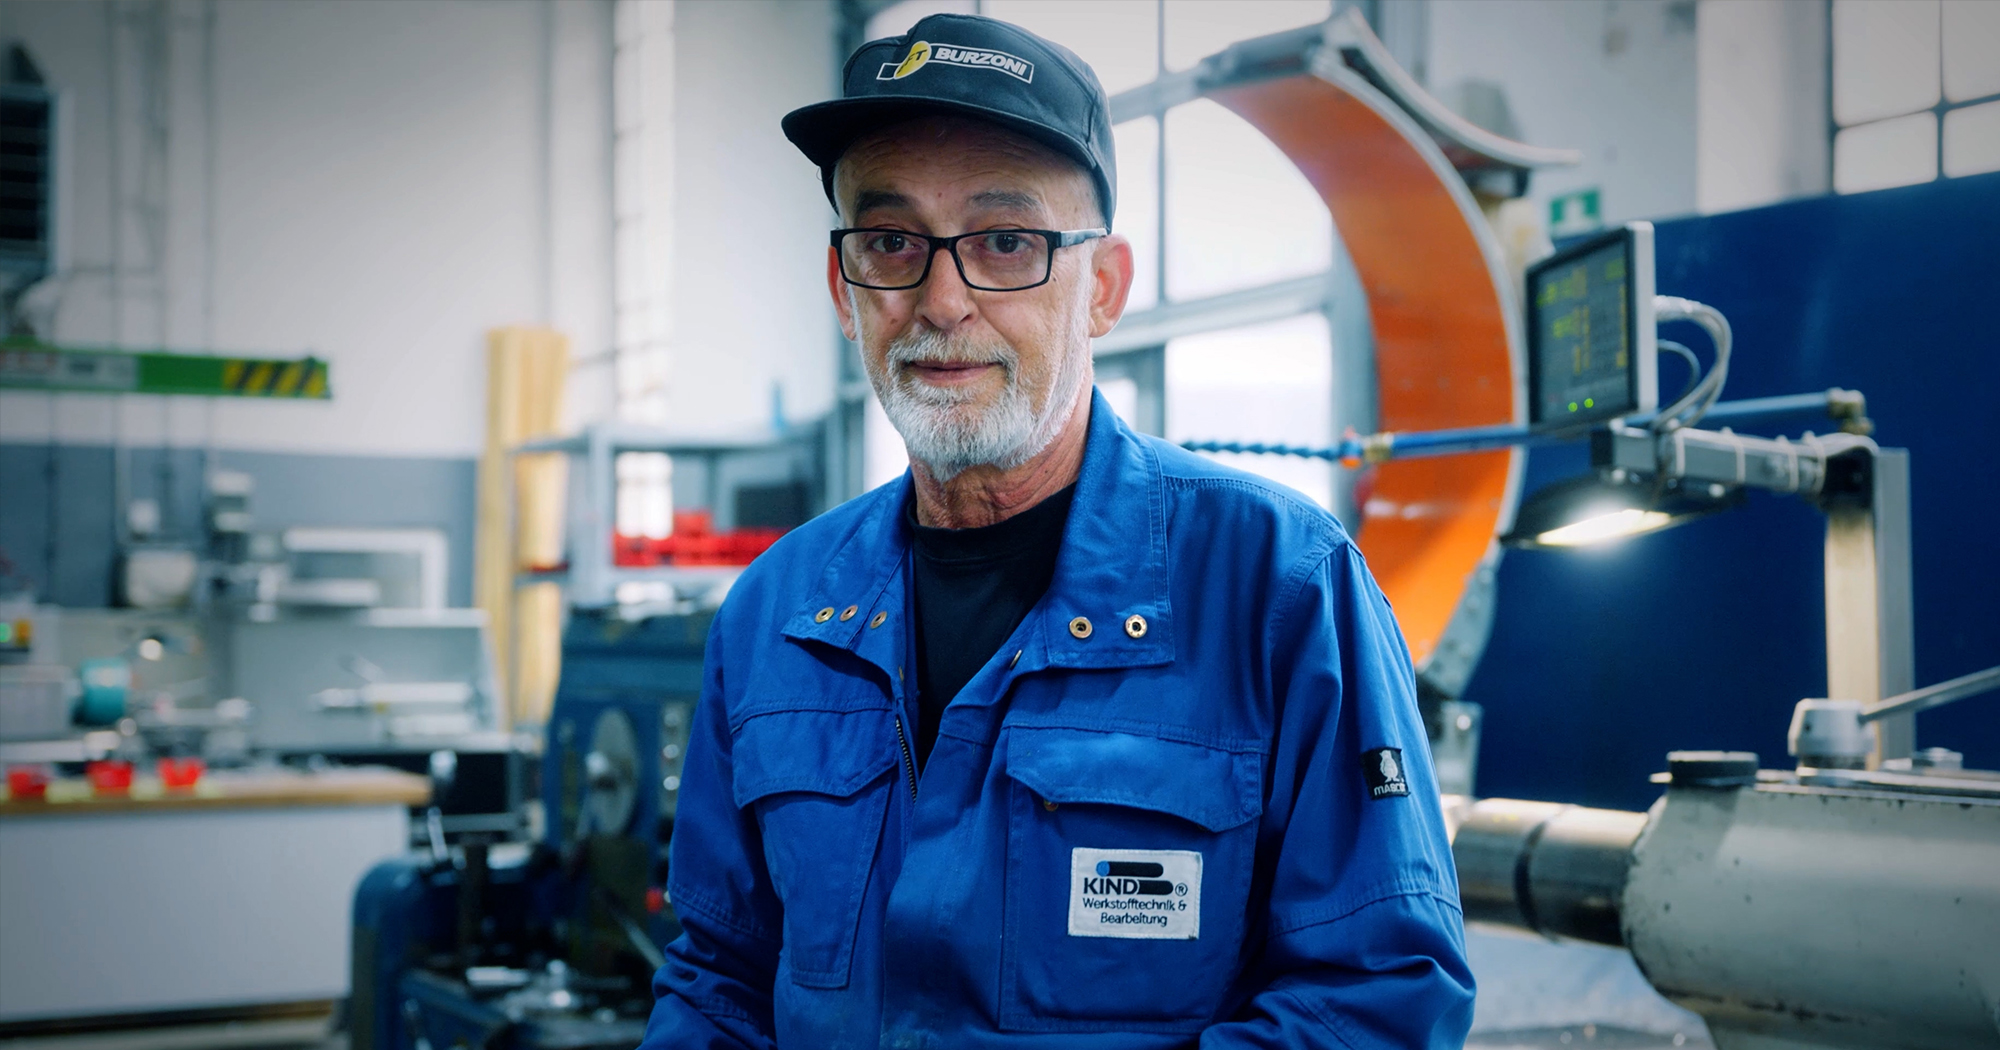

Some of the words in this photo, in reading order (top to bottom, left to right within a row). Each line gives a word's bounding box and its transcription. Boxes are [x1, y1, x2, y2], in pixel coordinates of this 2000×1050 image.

[934, 47, 1028, 76] BURZONI
[1083, 877, 1138, 896] KIND
[1082, 897, 1176, 912] Werkstofftechnik
[1178, 901, 1187, 911] &
[1100, 912, 1168, 927] Bearbeitung
